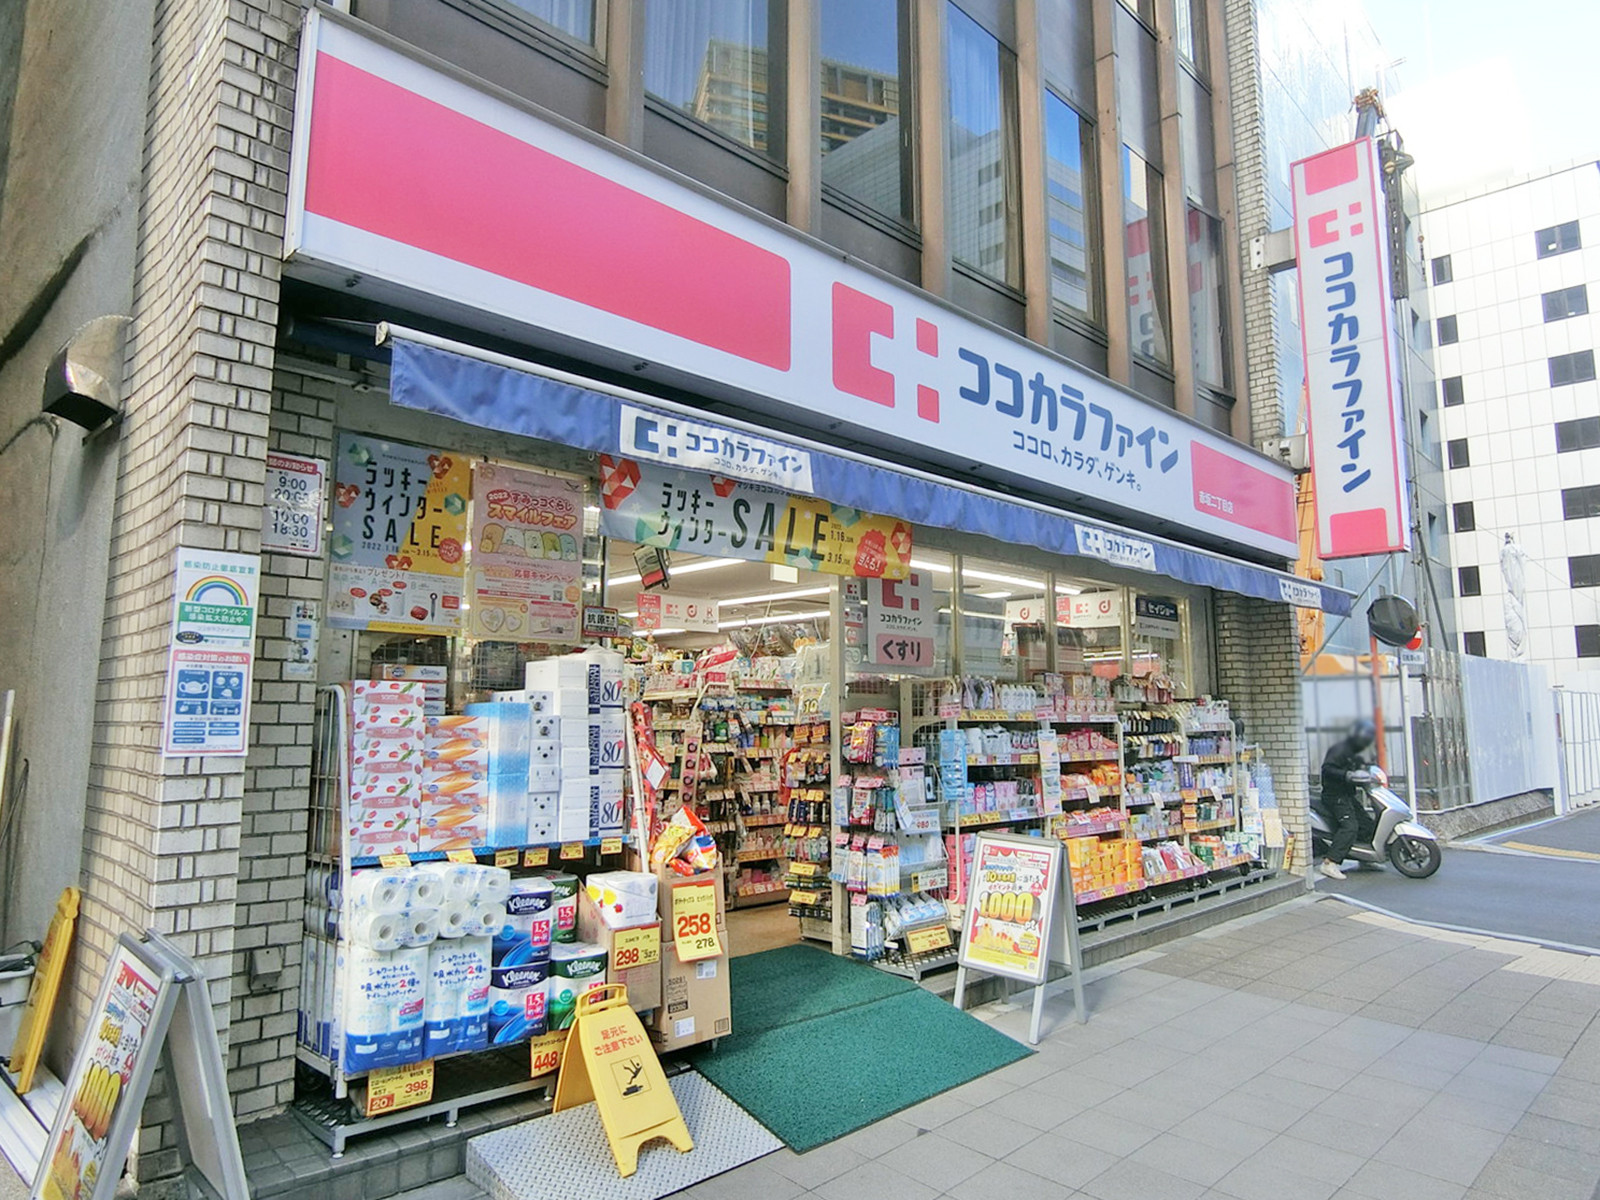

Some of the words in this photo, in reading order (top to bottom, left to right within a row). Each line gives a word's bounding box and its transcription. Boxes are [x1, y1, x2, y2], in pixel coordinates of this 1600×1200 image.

[1323, 251, 1371, 493] ココカラファイン
[958, 346, 1179, 475] ココカラファイン
[686, 431, 803, 474] ココカラファイン
[1012, 429, 1142, 492] ココロ、カラダ、ゲンキ。
[278, 475, 307, 491] 9:00
[364, 460, 428, 491] ラッキー
[274, 487, 308, 502] 20:0
[364, 487, 443, 520] ウィンター
[661, 482, 715, 512] ラッキー
[487, 502, 578, 531] スマイルフェア
[272, 522, 308, 538] 18:30
[362, 514, 442, 549] SALE
[657, 511, 727, 545] ウィンター
[729, 498, 830, 562] SALE
[184, 605, 249, 617] 新型コロナウイルス
[188, 613, 244, 624] 感染拡大防止中
[880, 613, 923, 627] ココカラファイン
[882, 639, 922, 663] くすり
[601, 680, 622, 702] 80
[601, 741, 622, 763] 80
[601, 801, 621, 824] 80
[508, 896, 547, 912] Kleenex
[677, 912, 711, 938] 258
[695, 937, 715, 949] 278
[566, 960, 602, 976] Kleenex
[616, 947, 640, 967] 298
[501, 969, 541, 986] Kleenex
[600, 1024, 628, 1041] 足元に
[593, 1035, 644, 1057] ご注意下さい
[533, 1051, 559, 1071] 448
[405, 1079, 429, 1094] 398
[372, 1098, 389, 1110] 20
